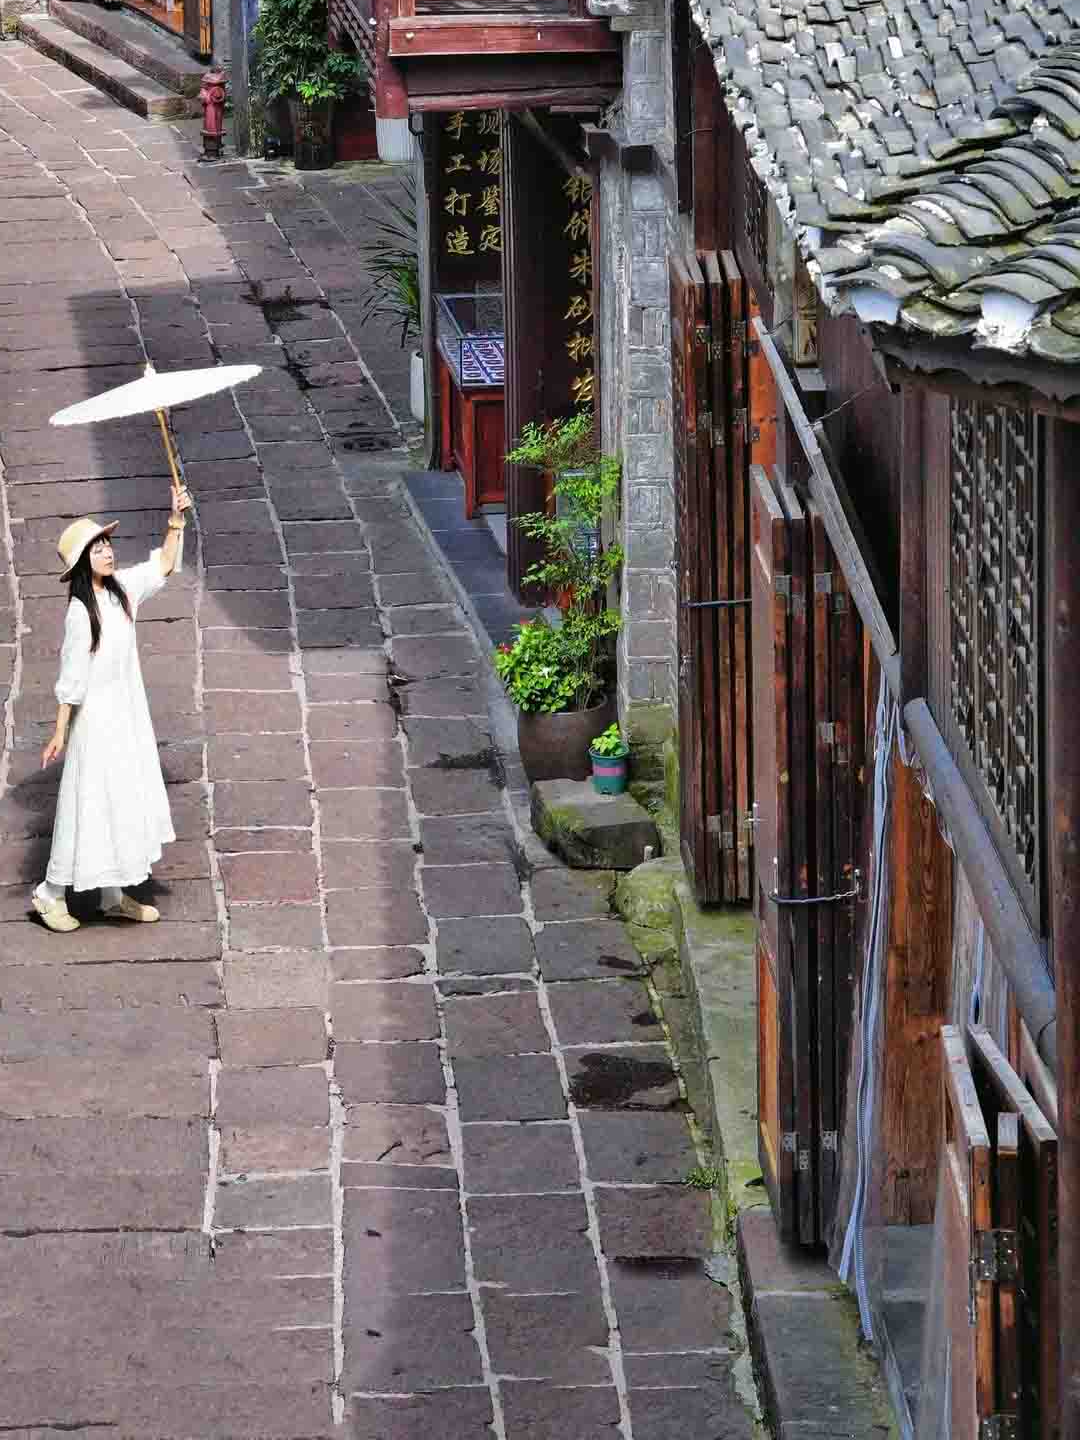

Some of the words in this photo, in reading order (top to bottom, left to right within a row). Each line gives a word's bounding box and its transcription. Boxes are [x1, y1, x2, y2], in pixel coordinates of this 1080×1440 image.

[444, 111, 475, 255] 手工打造
[476, 111, 504, 253] 现场鉴定
